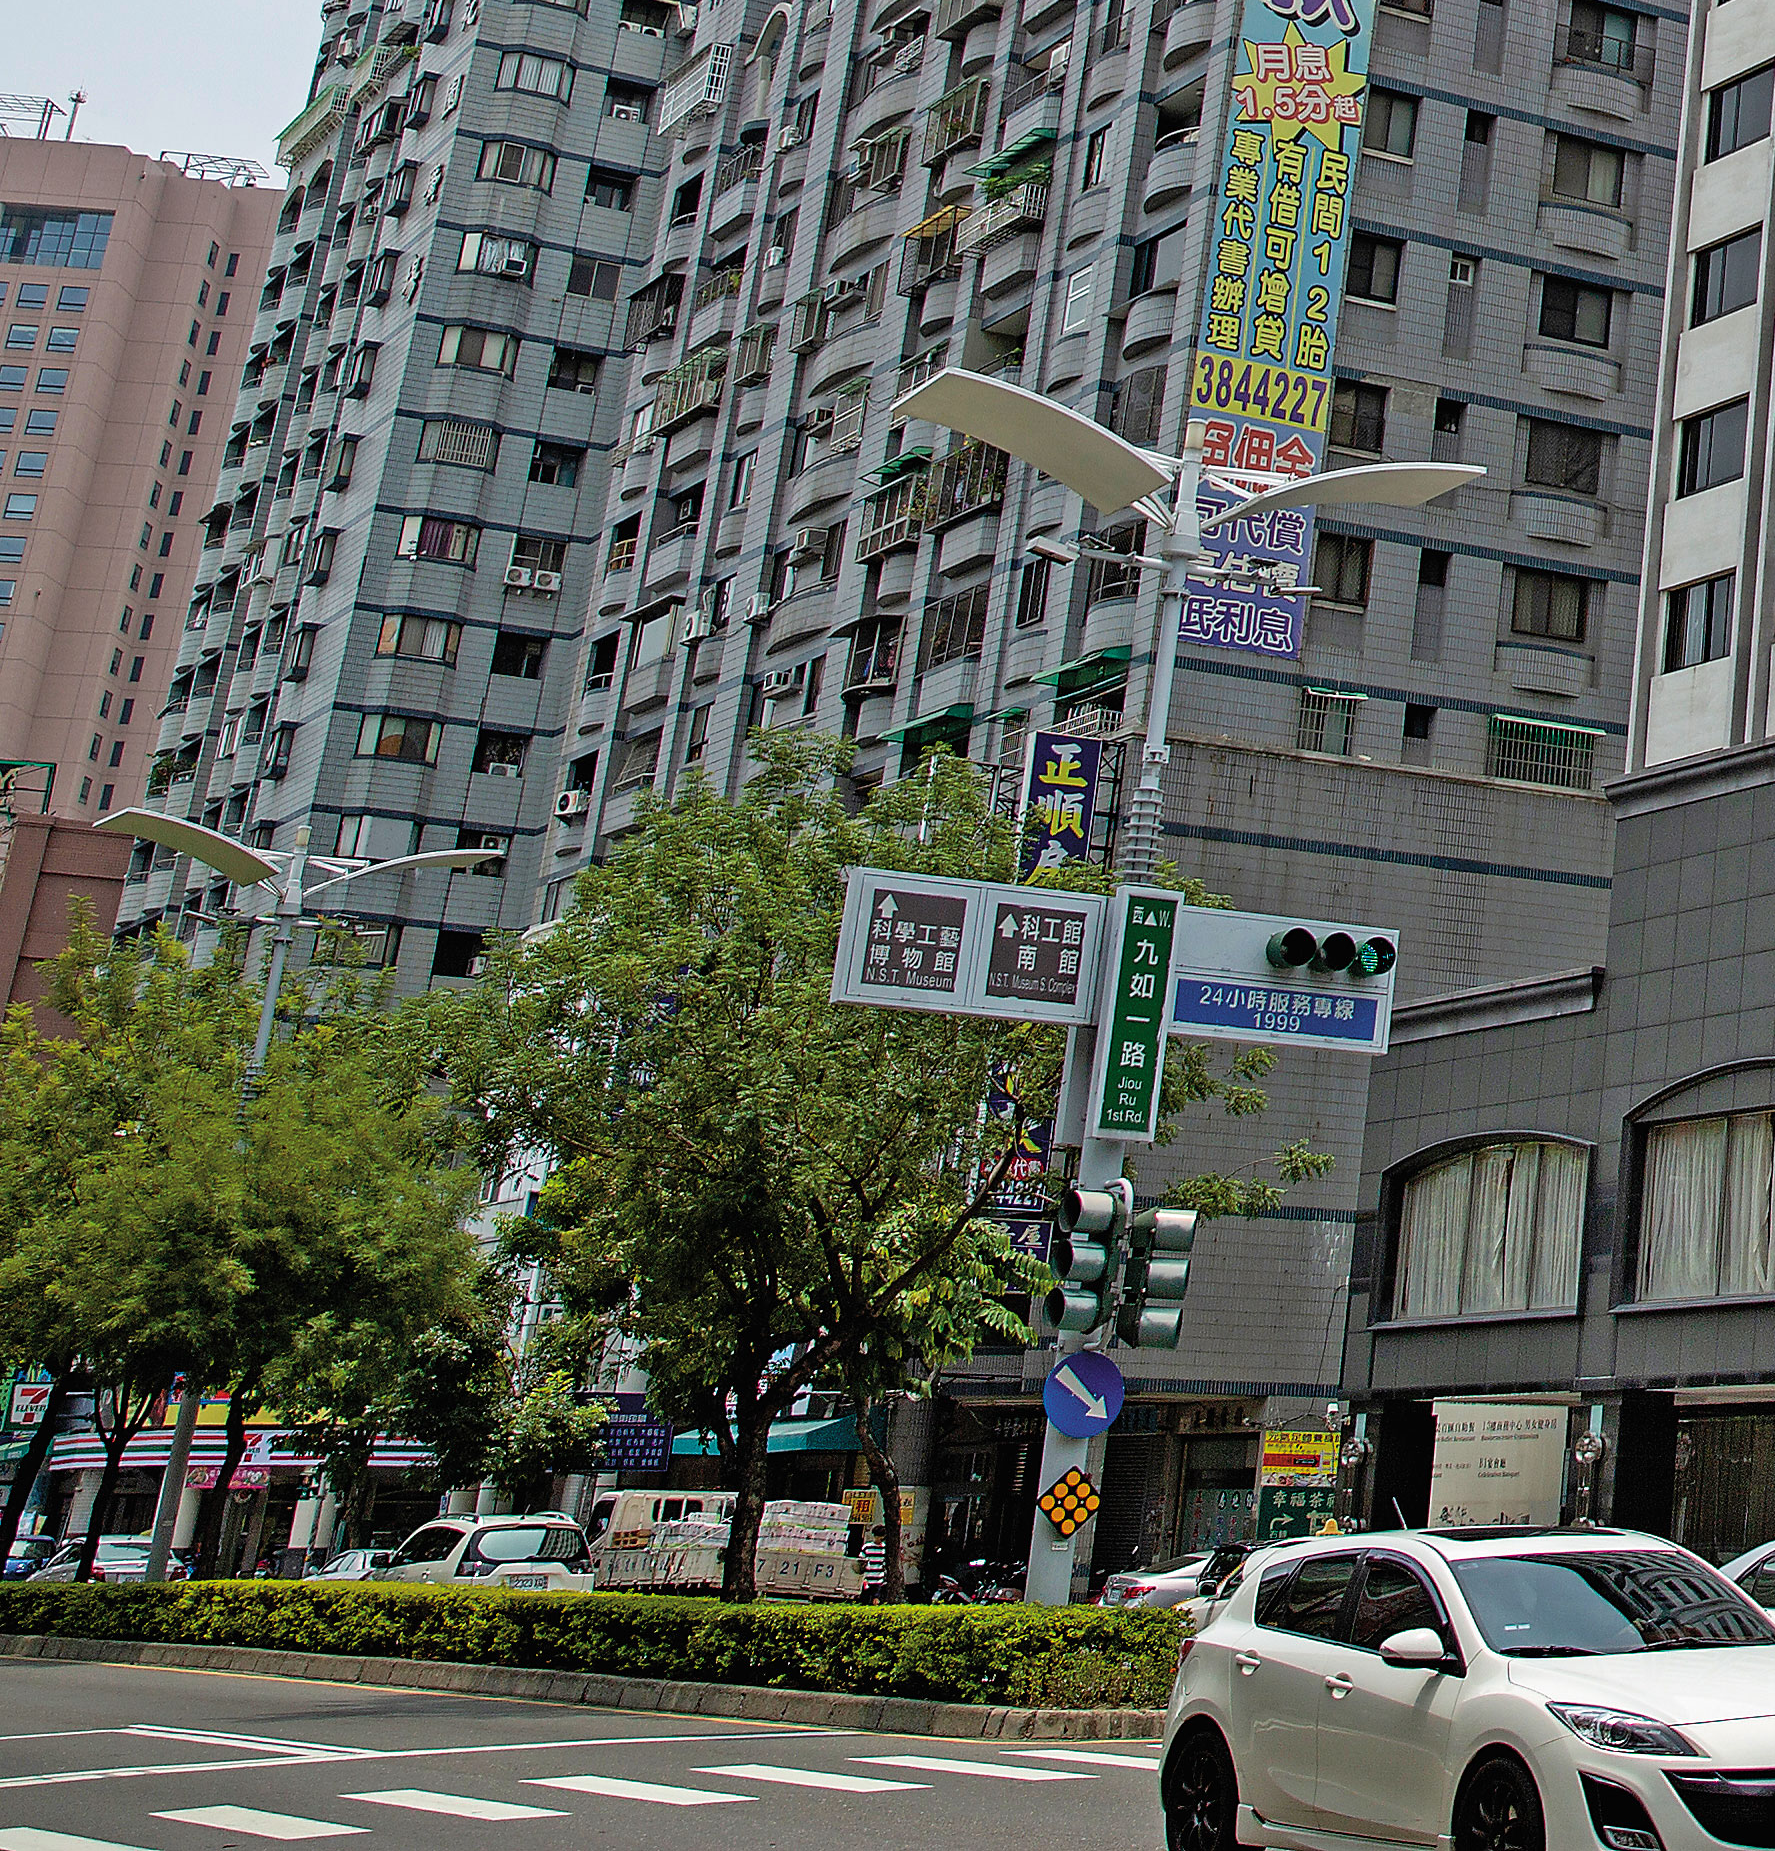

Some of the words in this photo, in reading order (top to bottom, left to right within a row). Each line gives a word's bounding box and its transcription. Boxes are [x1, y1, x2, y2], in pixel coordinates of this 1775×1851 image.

[1256, 43, 1332, 84] 月息
[1236, 86, 1358, 124] 1.5分起
[1207, 129, 1264, 352] 專業代書辦理
[1250, 138, 1305, 361] 有借可增貸
[1196, 357, 1327, 428] 3844227
[872, 919, 960, 947] 科學工藝
[1021, 914, 1083, 945] 科工館
[869, 944, 956, 973] 博物館
[866, 967, 899, 984] N.S.T.
[906, 971, 953, 988] Museum
[1012, 975, 1039, 991] Museum
[1049, 977, 1076, 995] Complex
[1120, 939, 1159, 1069] 九如一路
[1200, 985, 1355, 1020] 24小時服務專線
[1253, 1012, 1301, 1032] 1999
[1117, 1076, 1142, 1090] Jiou
[1120, 1093, 1136, 1106] Ru
[1107, 1109, 1124, 1122] 1st
[1125, 1110, 1144, 1123] Rd.
